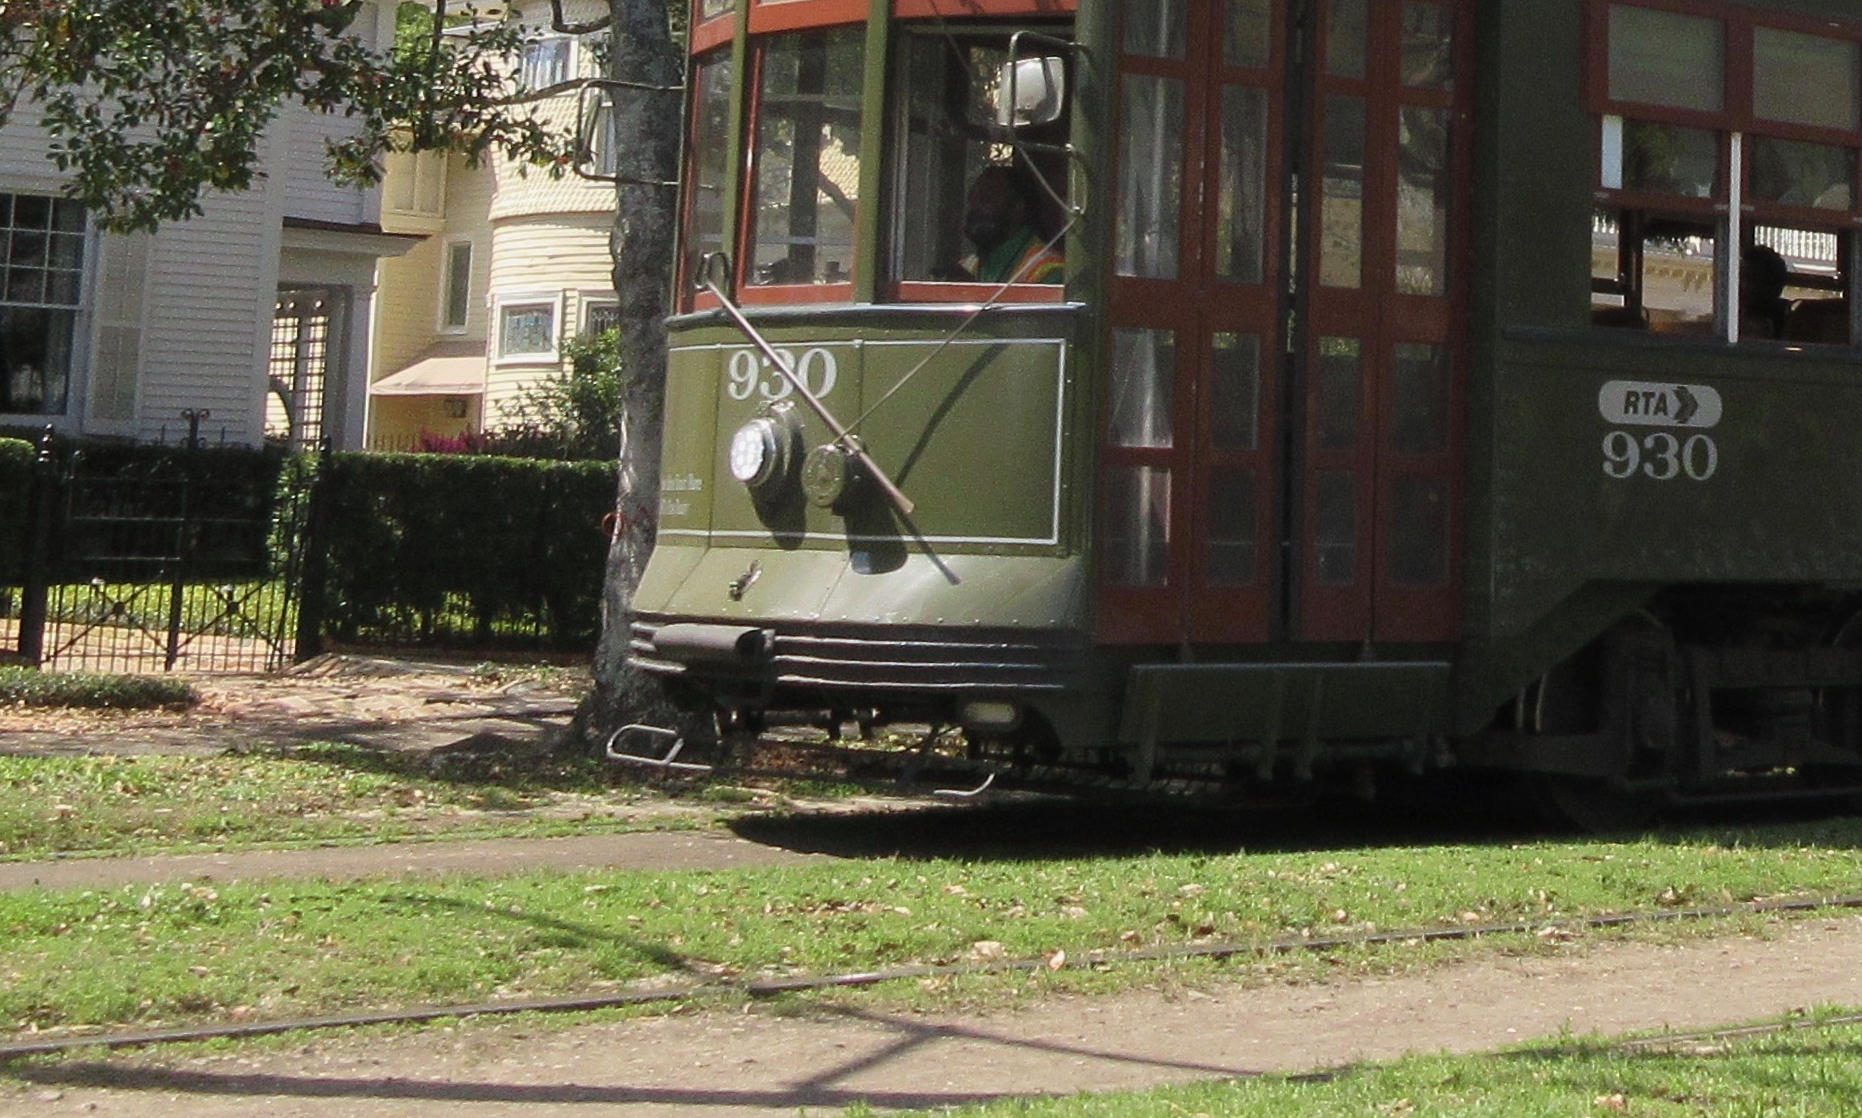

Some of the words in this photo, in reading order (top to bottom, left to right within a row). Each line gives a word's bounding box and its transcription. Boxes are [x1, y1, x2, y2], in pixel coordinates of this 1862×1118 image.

[727, 348, 838, 400] 930
[1624, 390, 1669, 416] RTA
[1602, 430, 1718, 481] 930
